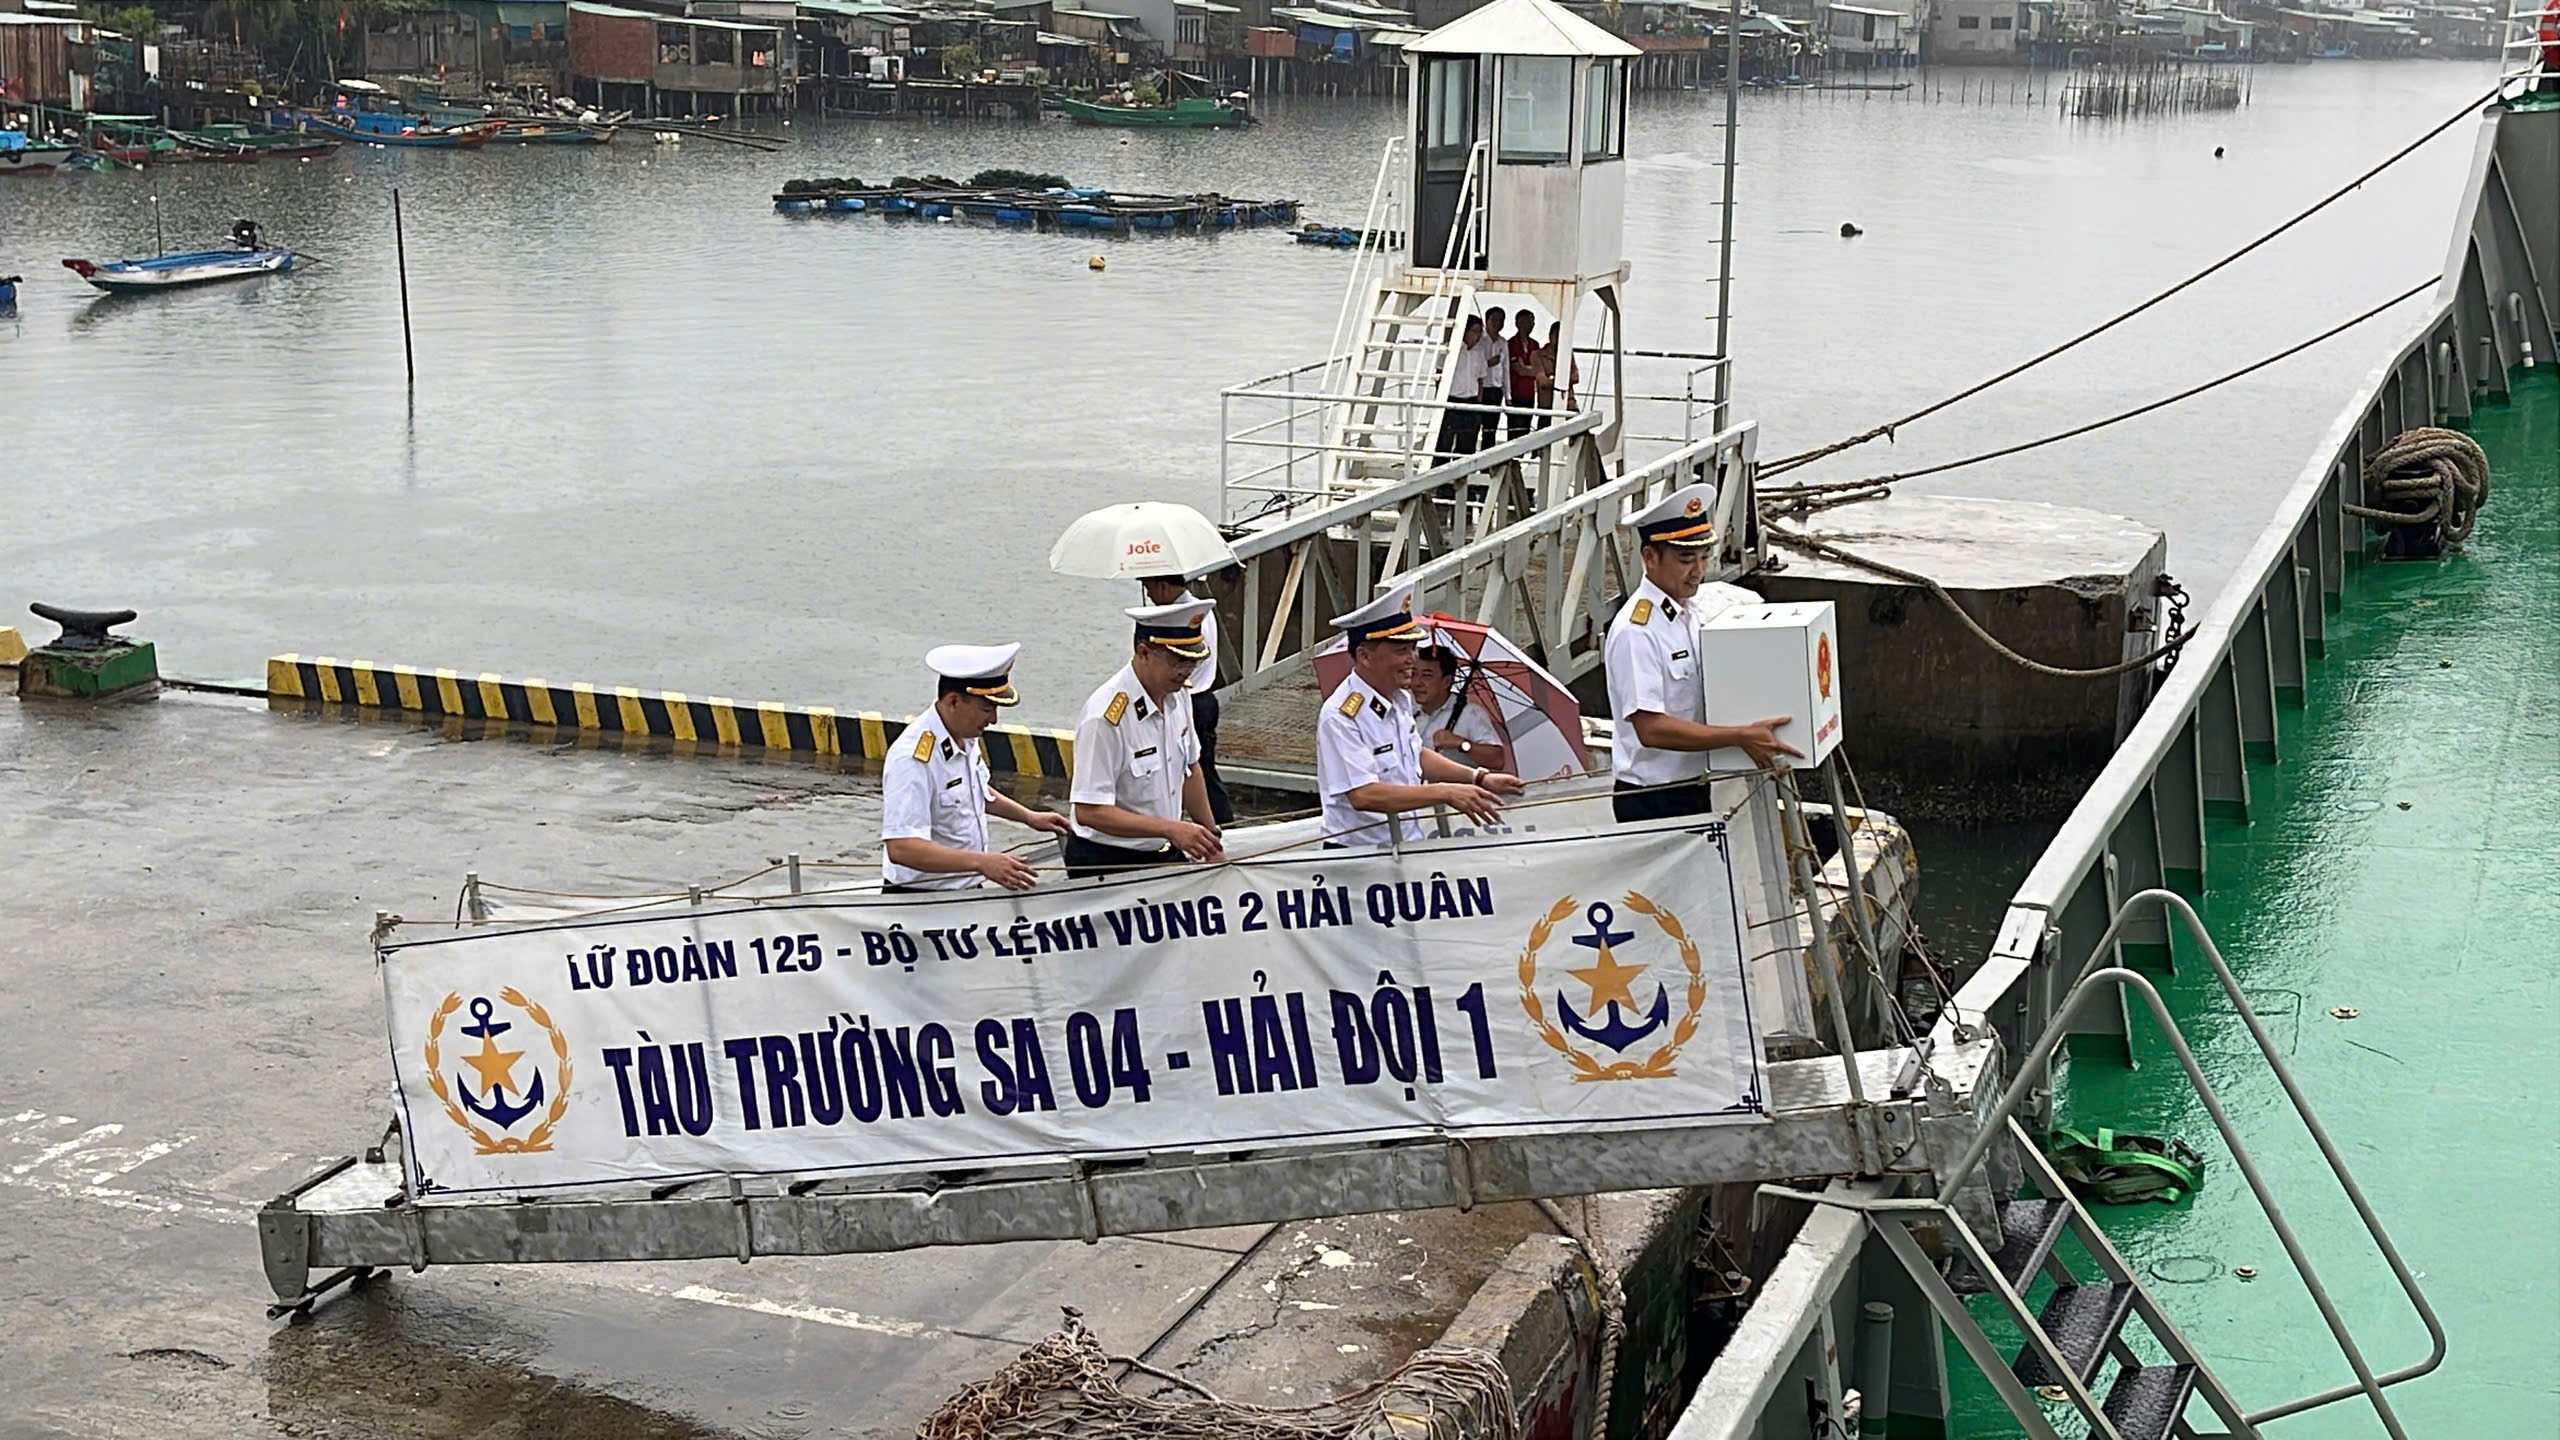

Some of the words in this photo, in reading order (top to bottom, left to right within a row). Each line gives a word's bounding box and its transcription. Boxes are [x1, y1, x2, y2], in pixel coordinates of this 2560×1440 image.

[1127, 540, 1161, 555] Joie
[567, 944, 616, 990] LỮ
[626, 936, 737, 987] ĐOÀN
[750, 933, 821, 975] 125
[836, 948, 852, 957] -
[861, 922, 919, 973] BỘ
[922, 923, 979, 961] TƯ
[986, 914, 1098, 965] LỆNH
[1104, 897, 1227, 947] VÙNG
[1238, 891, 1268, 932] 2
[1277, 874, 1354, 930] HẢI
[1365, 871, 1494, 928] QUÂN
[601, 1028, 713, 1138] TÀU
[723, 1011, 966, 1131] TRƯỜNG
[974, 1017, 1058, 1117] SA
[1065, 1007, 1153, 1109] 04
[1166, 1050, 1191, 1071] -
[1201, 969, 1319, 1097] HẢI
[1329, 970, 1444, 1102] ĐỘI
[1456, 981, 1498, 1080] 1
